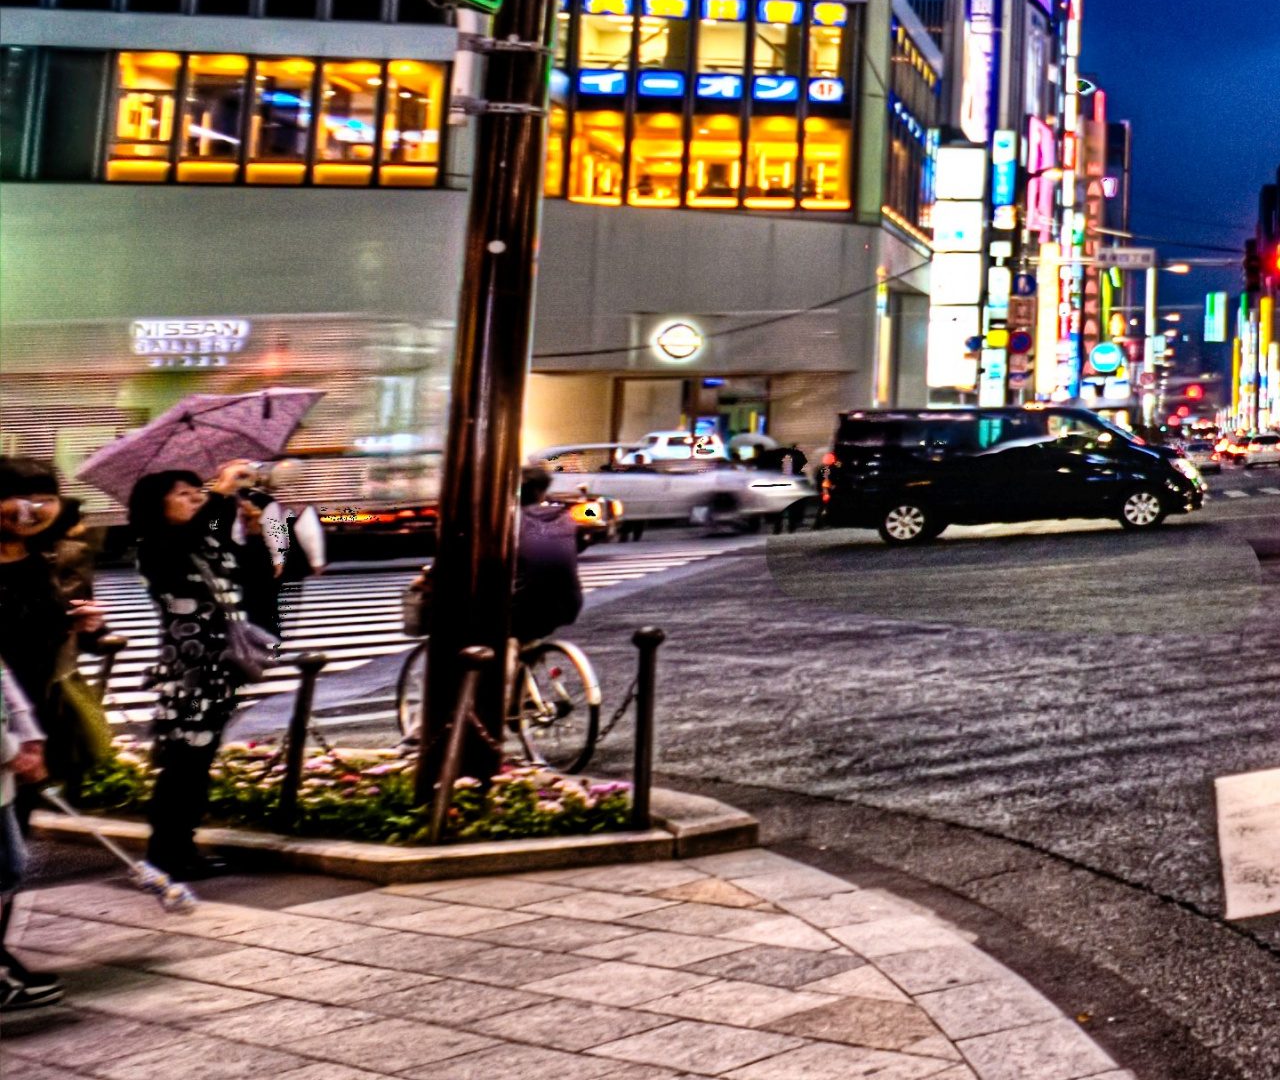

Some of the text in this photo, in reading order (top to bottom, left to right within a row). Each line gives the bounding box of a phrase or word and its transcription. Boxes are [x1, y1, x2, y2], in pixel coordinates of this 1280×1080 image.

[579, 72, 797, 99] イーオン
[132, 320, 248, 337] NISSAN
